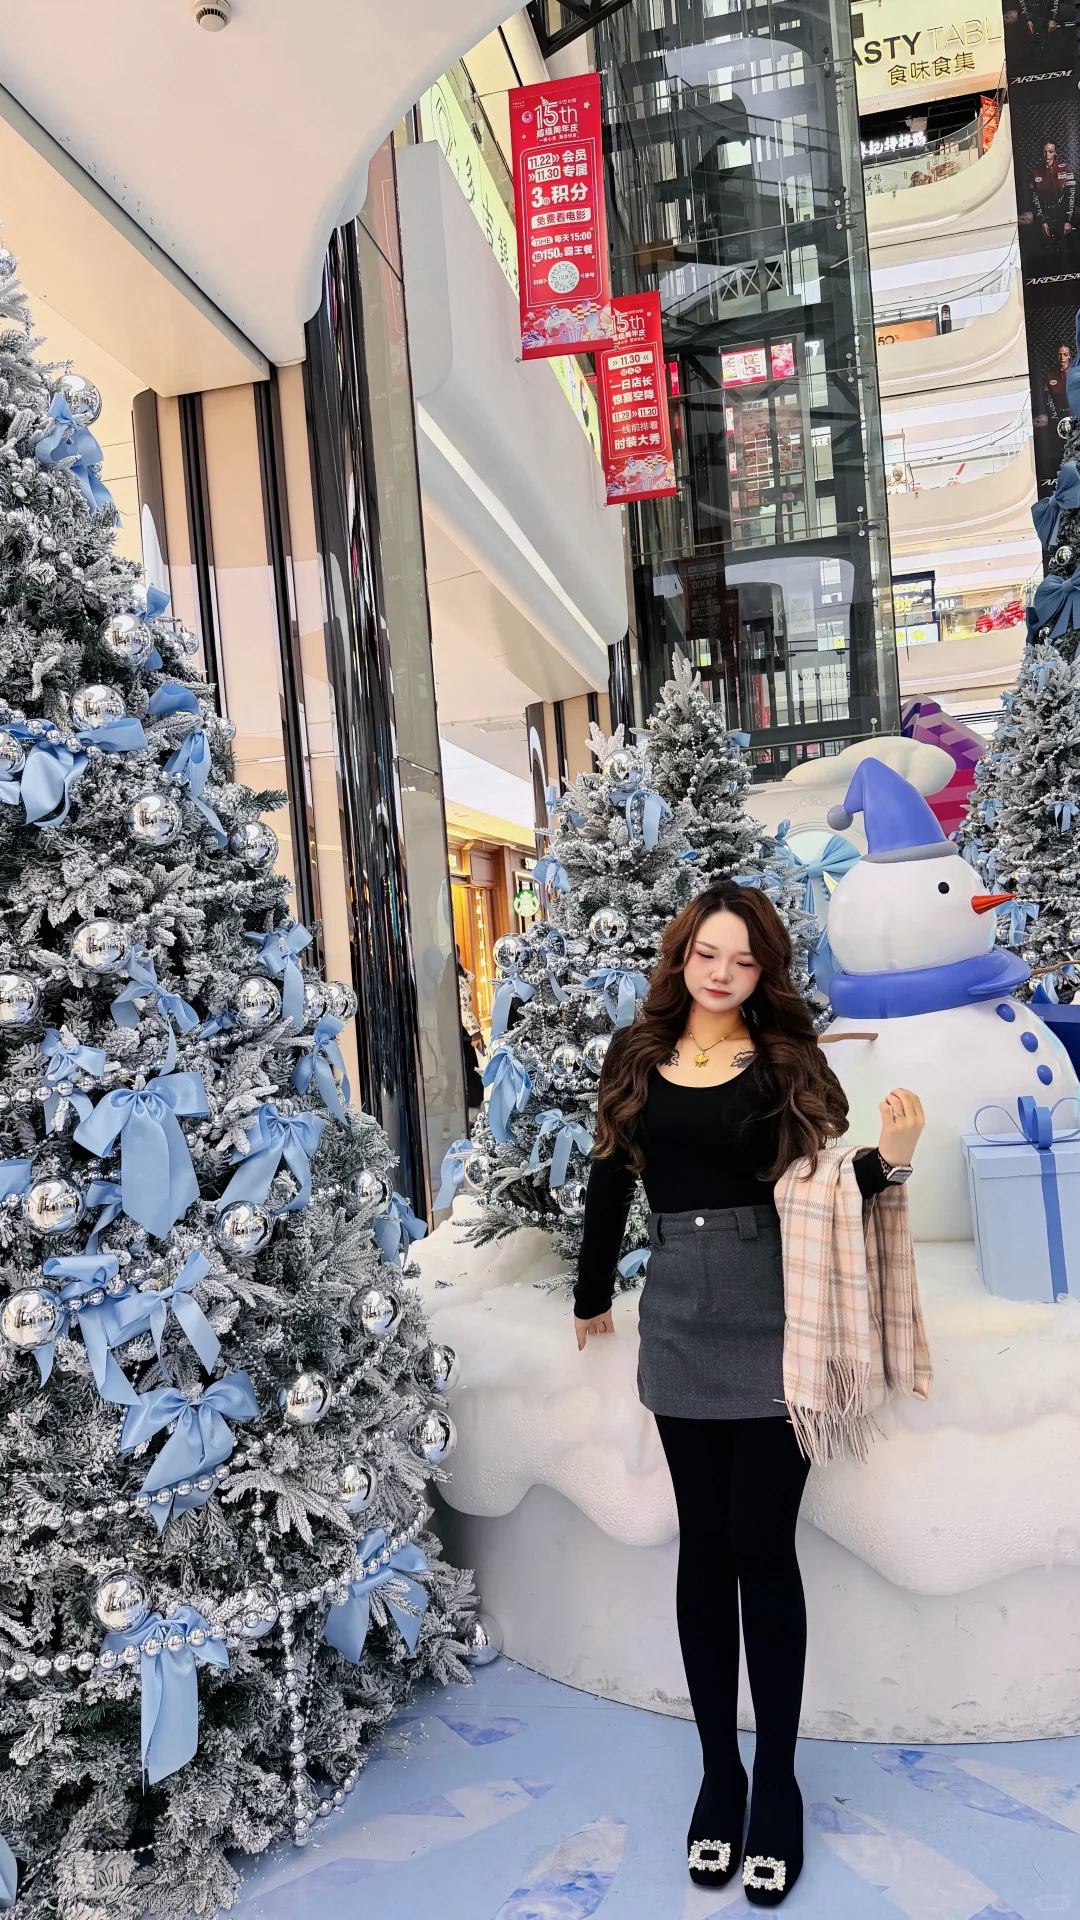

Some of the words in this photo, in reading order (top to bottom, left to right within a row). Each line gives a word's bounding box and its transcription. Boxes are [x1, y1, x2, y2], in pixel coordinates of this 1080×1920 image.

[927, 17, 1001, 52] TABL
[887, 52, 975, 85] 食味食集
[1011, 70, 1073, 84] ARISEISM
[534, 101, 578, 129] 15th
[537, 124, 578, 137] 超级周年庆
[529, 155, 551, 168] 11.22
[562, 149, 587, 163] 会员
[537, 168, 559, 181] 11.30
[563, 163, 588, 177] 专属
[537, 210, 586, 226] 免费看电影
[535, 237, 551, 246] TIME
[611, 312, 645, 334] 15th
[620, 354, 640, 365] 11.30
[611, 376, 652, 391] 一日店长
[612, 389, 655, 405] 惊喜空降
[614, 412, 630, 421] 11.29
[639, 408, 657, 416] 11.30
[613, 421, 658, 433] 一线前排看
[614, 433, 660, 450] 时装大秀
